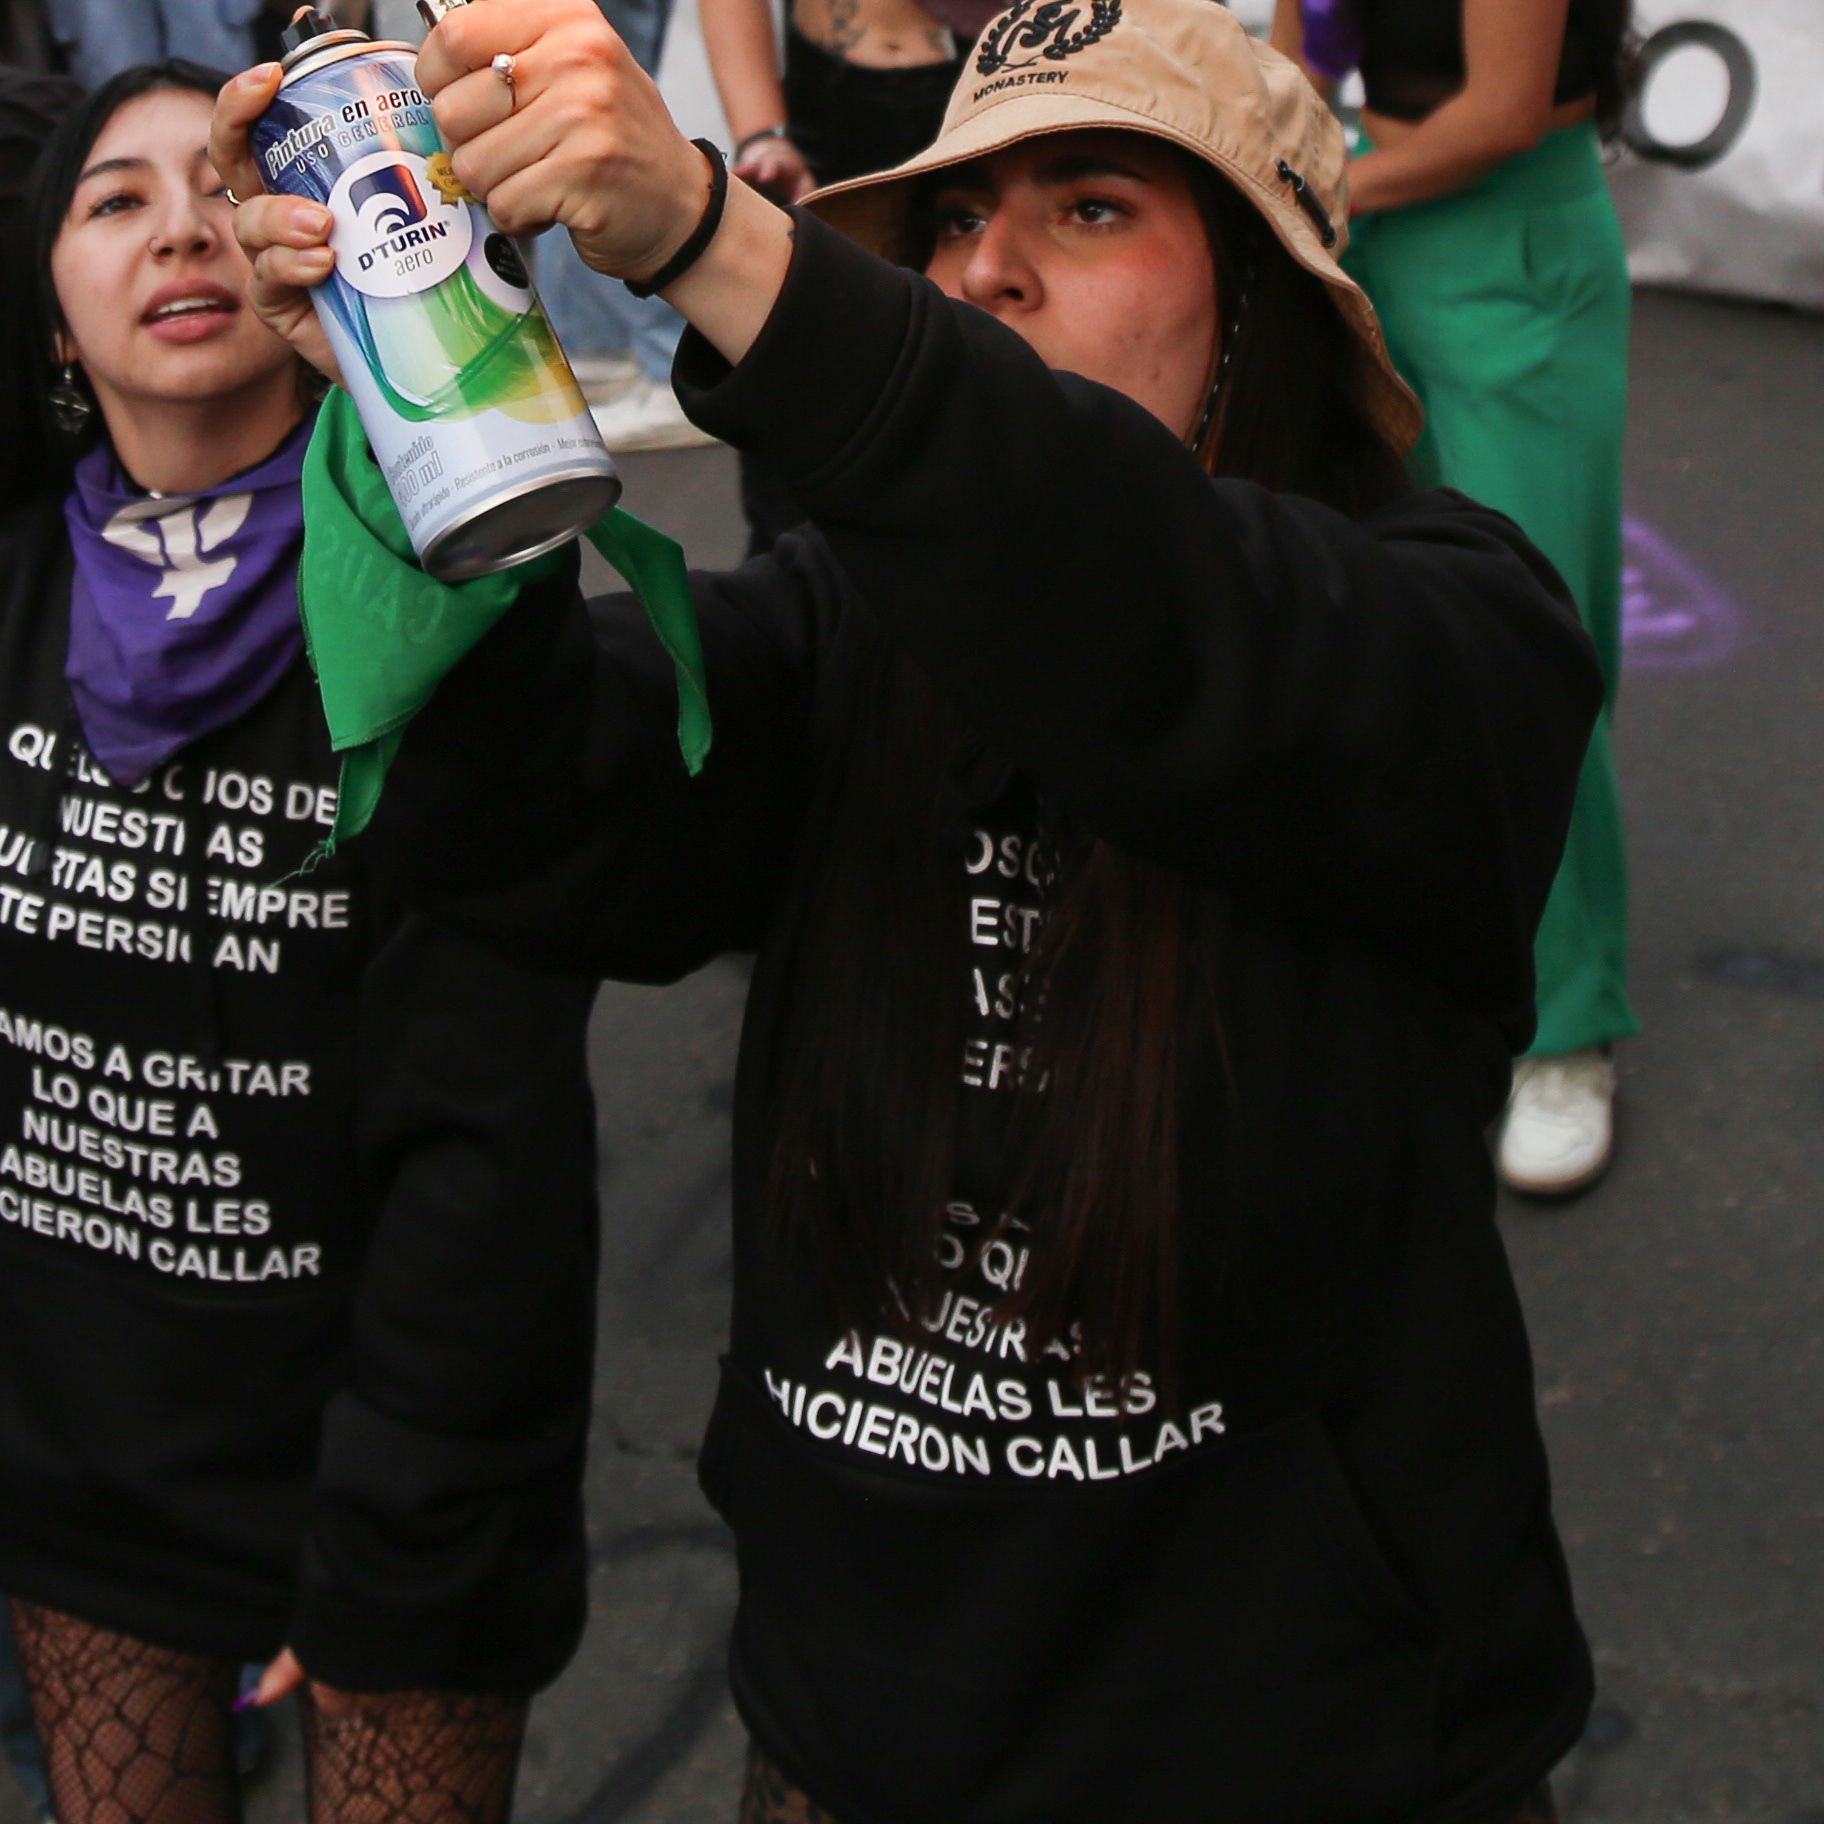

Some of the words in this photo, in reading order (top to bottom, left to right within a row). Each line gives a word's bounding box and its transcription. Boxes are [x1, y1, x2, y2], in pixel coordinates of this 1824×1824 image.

[971, 70, 1070, 104] MONASTERY
[265, 113, 337, 182] Pintura
[341, 99, 369, 124] en
[295, 146, 330, 174] USO
[338, 111, 430, 150] GENERAL
[394, 248, 434, 277] aero
[420, 451, 444, 486] ml
[497, 458, 504, 470] a
[503, 455, 512, 467] la
[284, 780, 338, 826] DE
[46, 904, 281, 975] PERSIAN
[102, 1043, 133, 1082] A
[31, 1067, 79, 1109] LO
[87, 1085, 177, 1137] QUE
[185, 1101, 219, 1140] A
[21, 1108, 242, 1188] NUESTRAS
[185, 1195, 271, 1237] LES
[147, 1236, 322, 1282] CALLAR
[825, 1328, 1035, 1422] ABUELAS
[1046, 1372, 1158, 1418] LES
[765, 1368, 992, 1478] HICIERON
[1004, 1400, 1227, 1482] CALLAR
